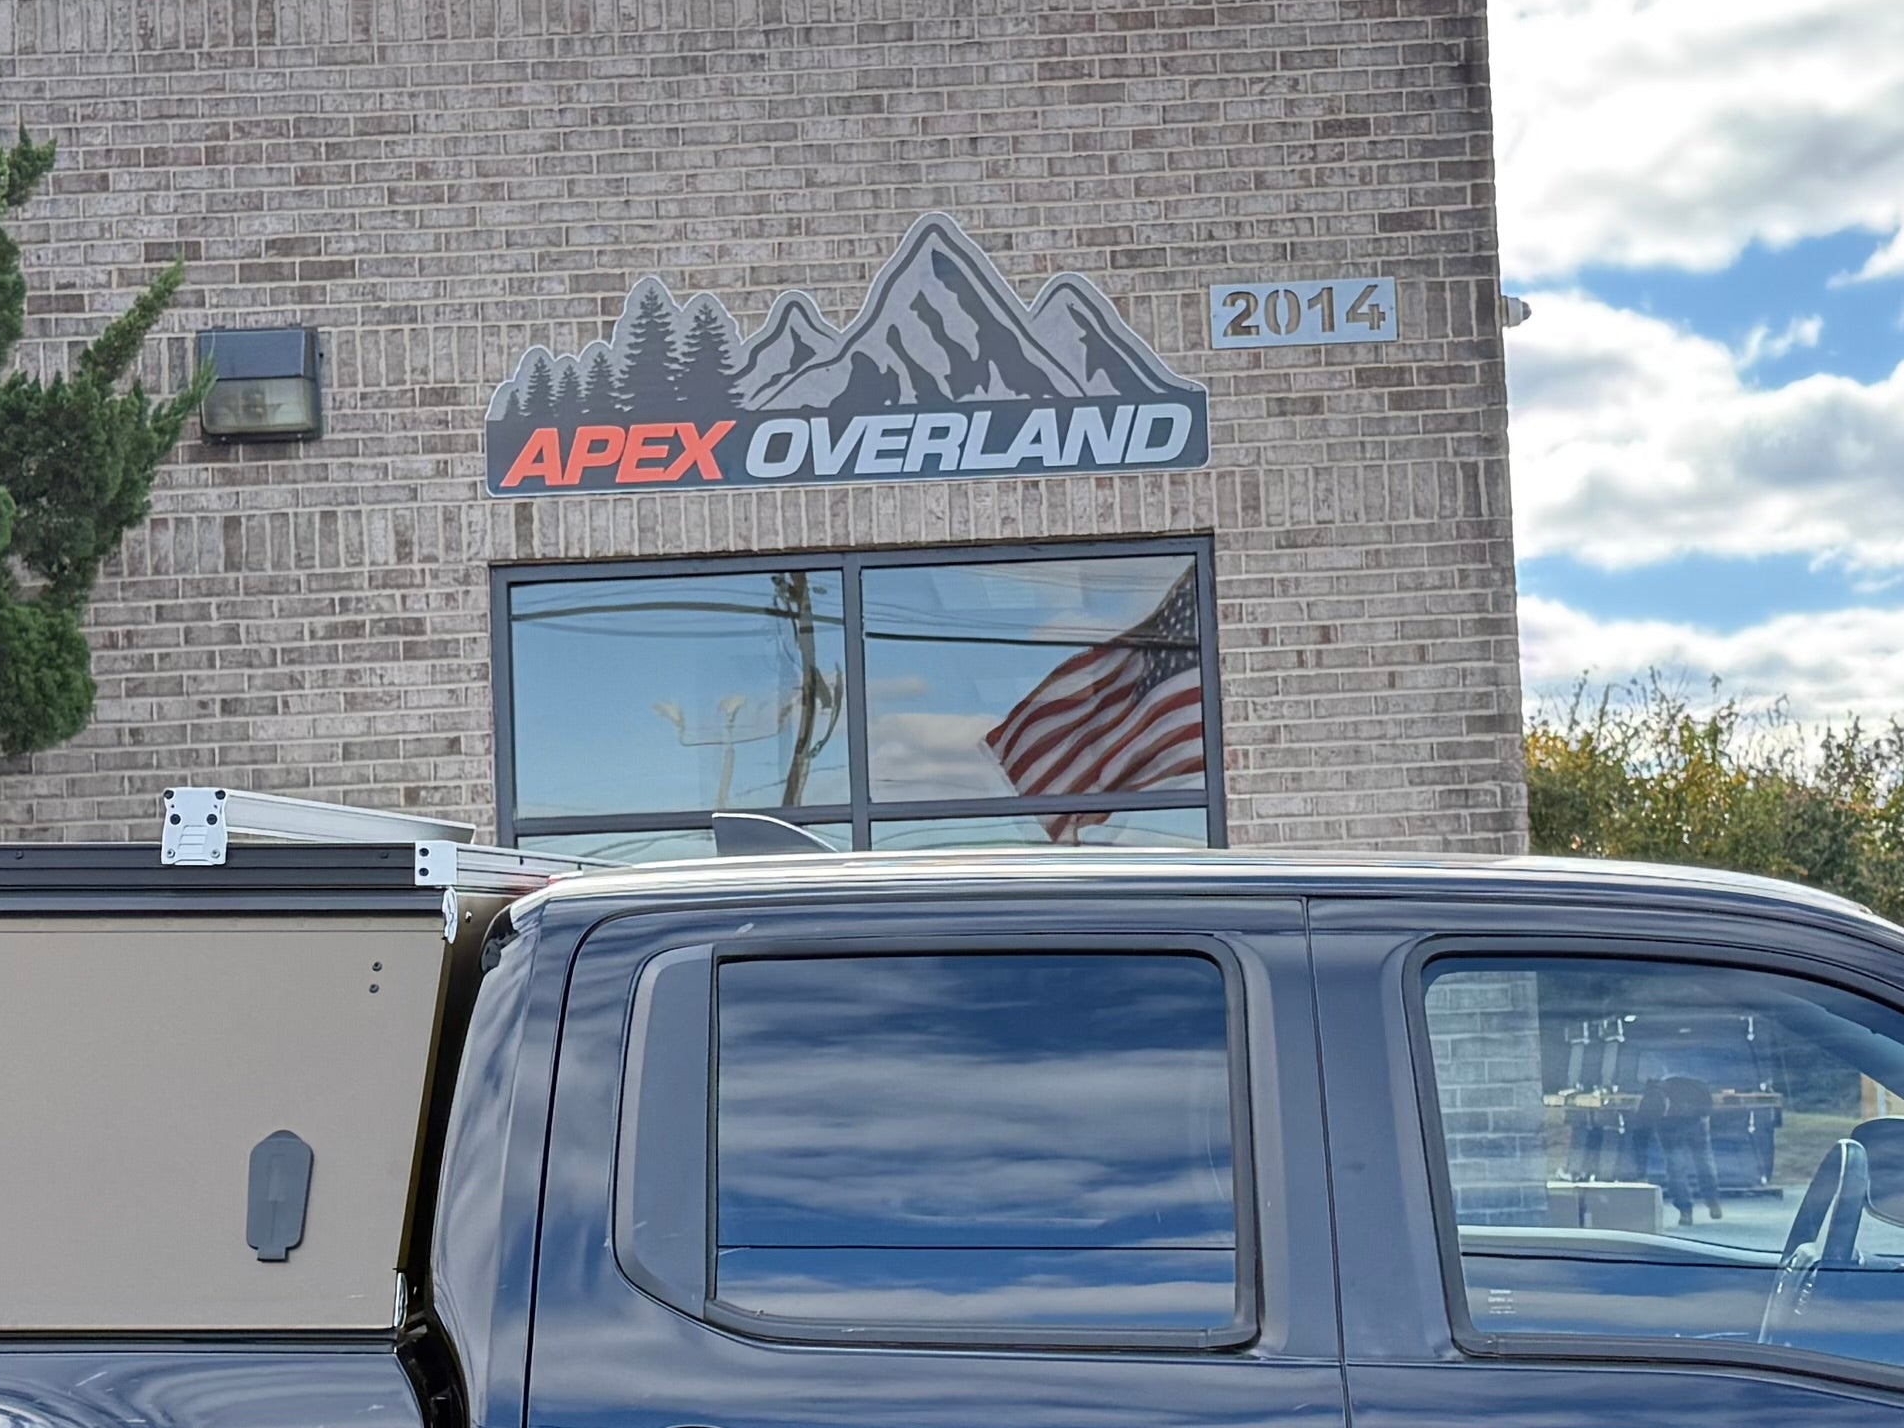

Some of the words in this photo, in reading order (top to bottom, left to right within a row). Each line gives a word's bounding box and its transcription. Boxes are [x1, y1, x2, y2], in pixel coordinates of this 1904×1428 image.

[1222, 284, 1386, 337] 2014
[500, 420, 737, 488] APEX
[745, 403, 1193, 479] OVERLAND
